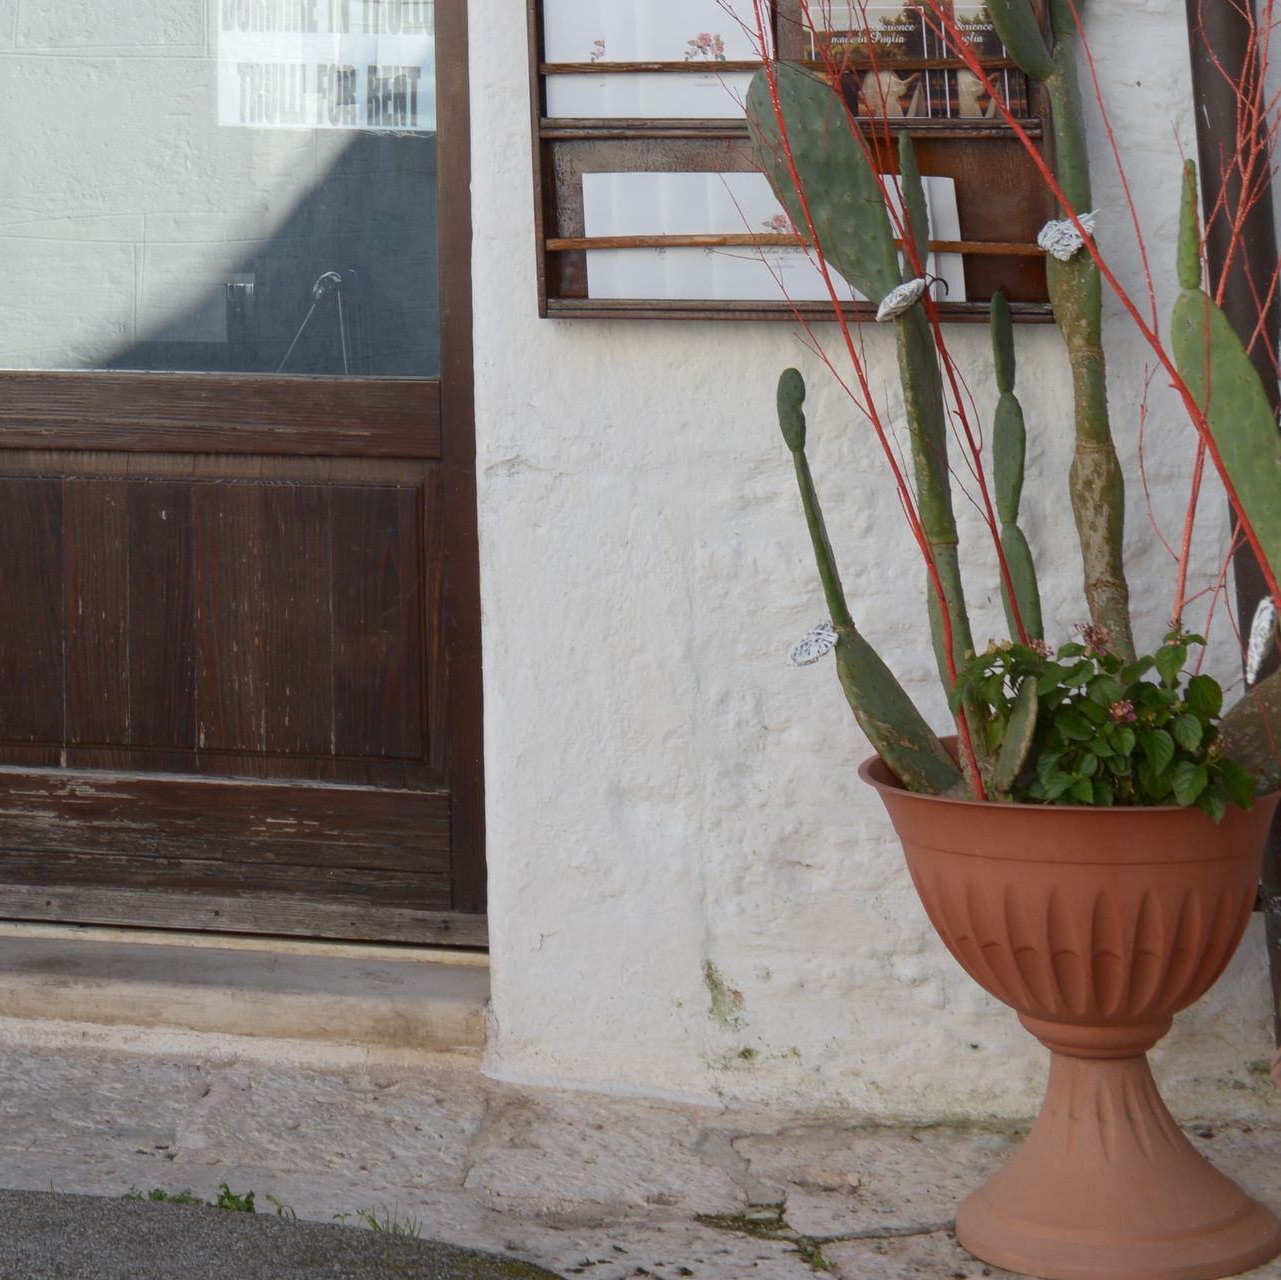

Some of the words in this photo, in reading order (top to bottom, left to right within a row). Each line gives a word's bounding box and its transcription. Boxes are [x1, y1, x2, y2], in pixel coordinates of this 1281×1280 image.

[237, 63, 306, 125] TRULLI
[316, 63, 357, 127] FOR
[366, 64, 422, 128] RENT
